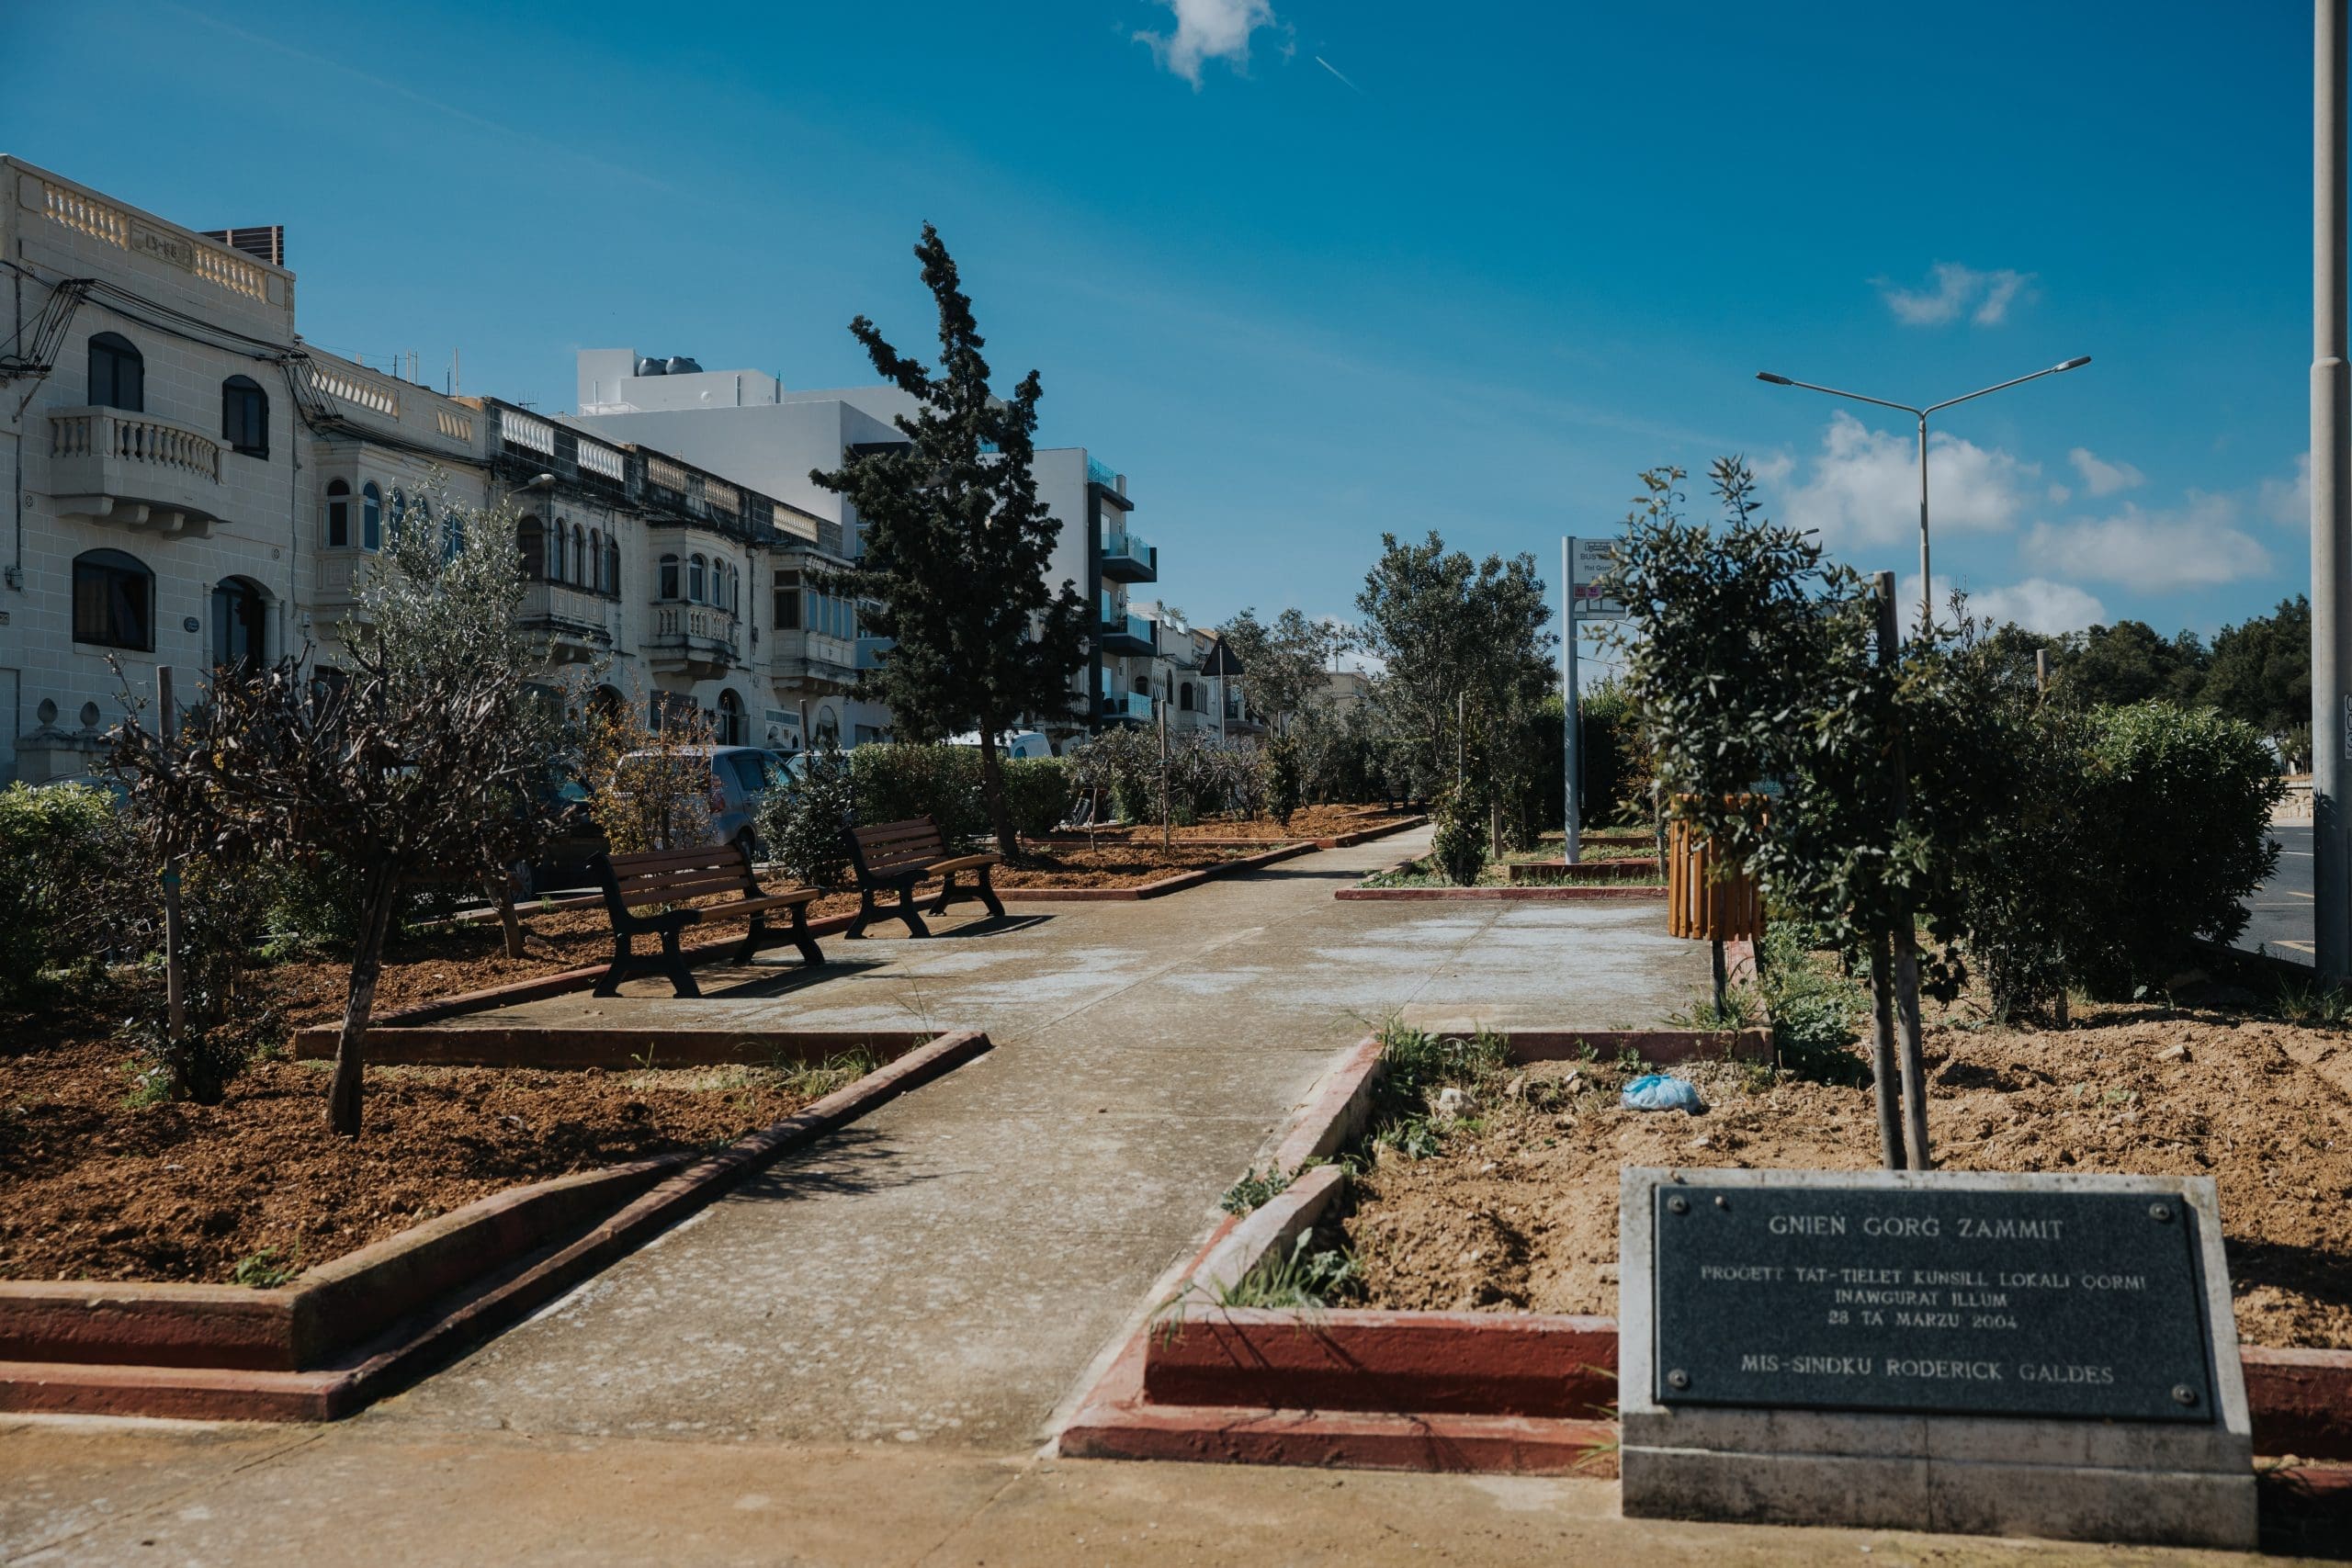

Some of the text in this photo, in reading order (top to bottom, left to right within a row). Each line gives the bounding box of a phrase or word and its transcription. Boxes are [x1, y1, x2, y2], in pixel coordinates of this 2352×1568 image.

[1958, 1218, 2064, 1240] ZAMMIT
[1795, 1268, 1903, 1284] TAT-TIELET
[1914, 1269, 1989, 1287] KUNSILL
[1999, 1271, 2071, 1289] LOKALI
[2081, 1274, 2146, 1292] QORMI
[1835, 1289, 2007, 1308] INAWGURAT ILLUM
[1827, 1310, 1849, 1325] 28
[1895, 1311, 1961, 1328] MARZU
[1972, 1314, 2018, 1330] 2004
[1741, 1354, 2115, 1385] MIS-SINDKU RODERICK GALDES
